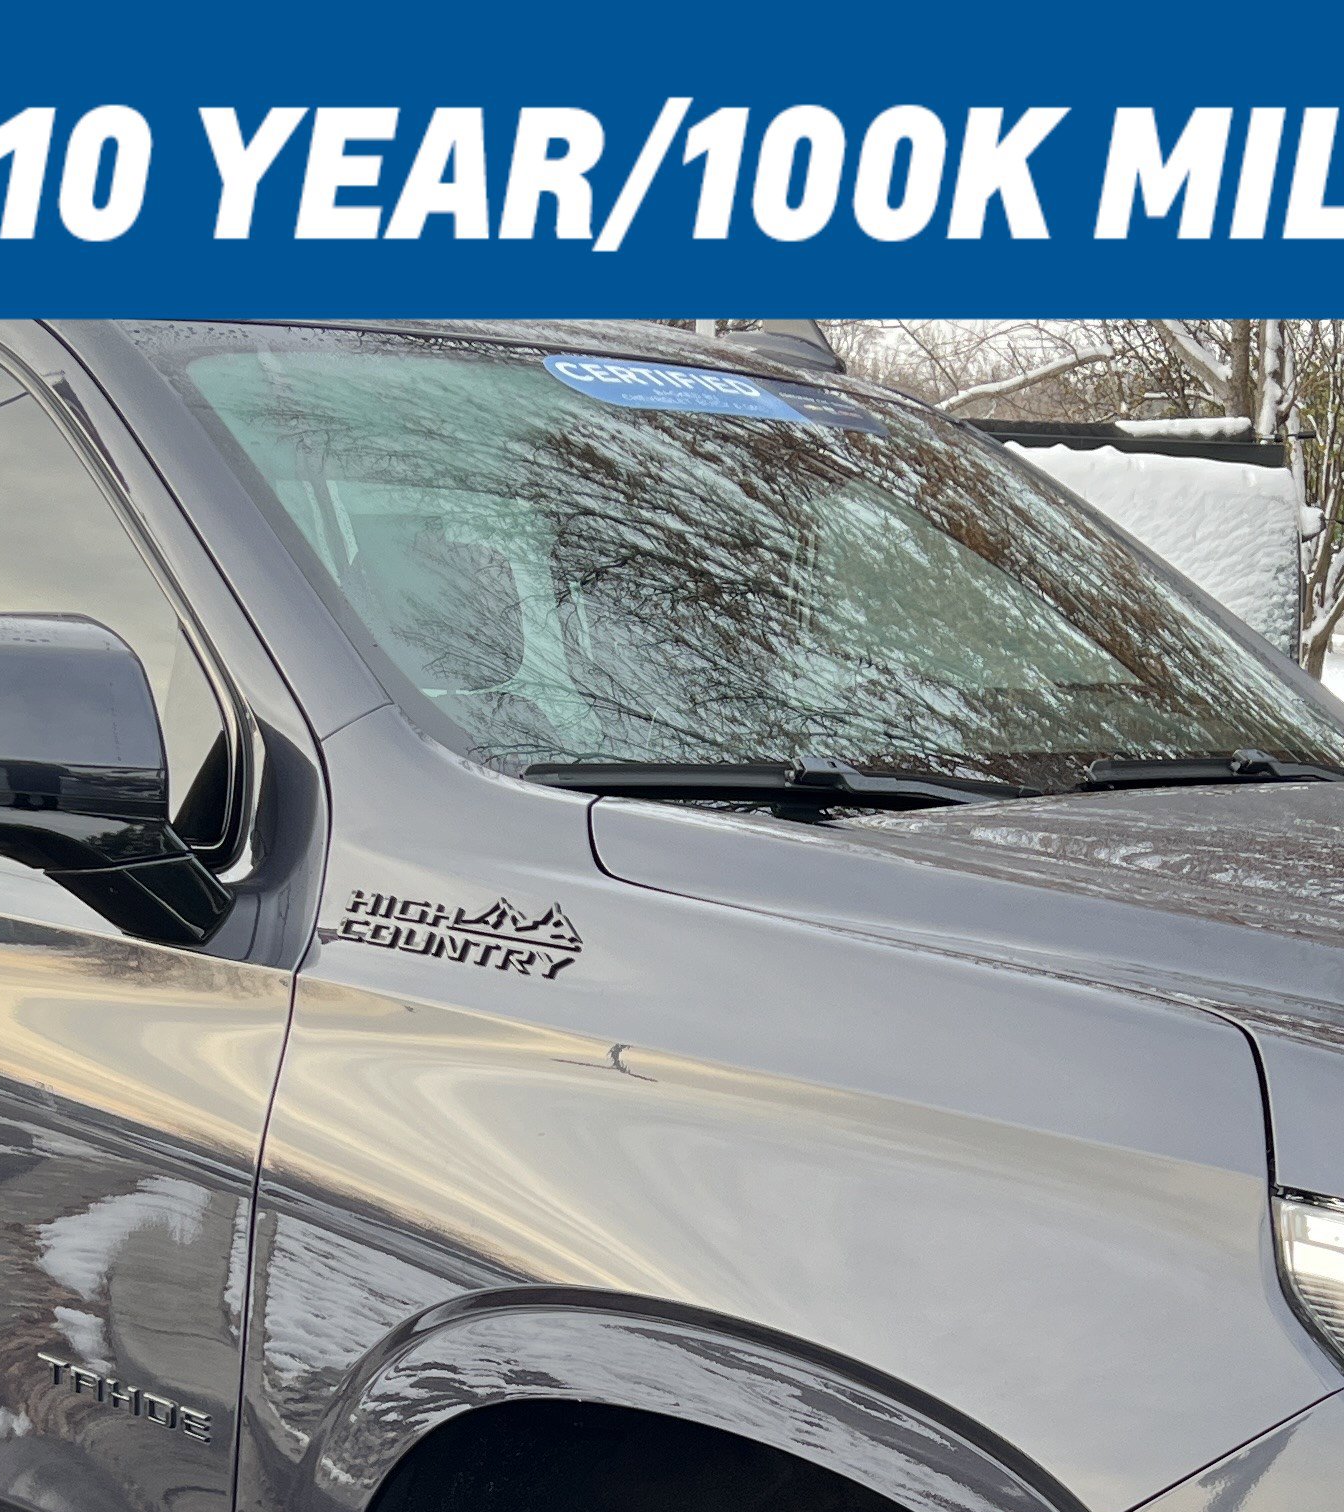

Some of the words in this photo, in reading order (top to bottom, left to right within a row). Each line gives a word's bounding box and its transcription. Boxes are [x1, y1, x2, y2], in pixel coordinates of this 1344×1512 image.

[555, 361, 761, 398] CERTIFIED
[346, 889, 466, 927] HIGH
[336, 917, 576, 980] COUNTRY
[37, 1352, 213, 1444] TAHOE
